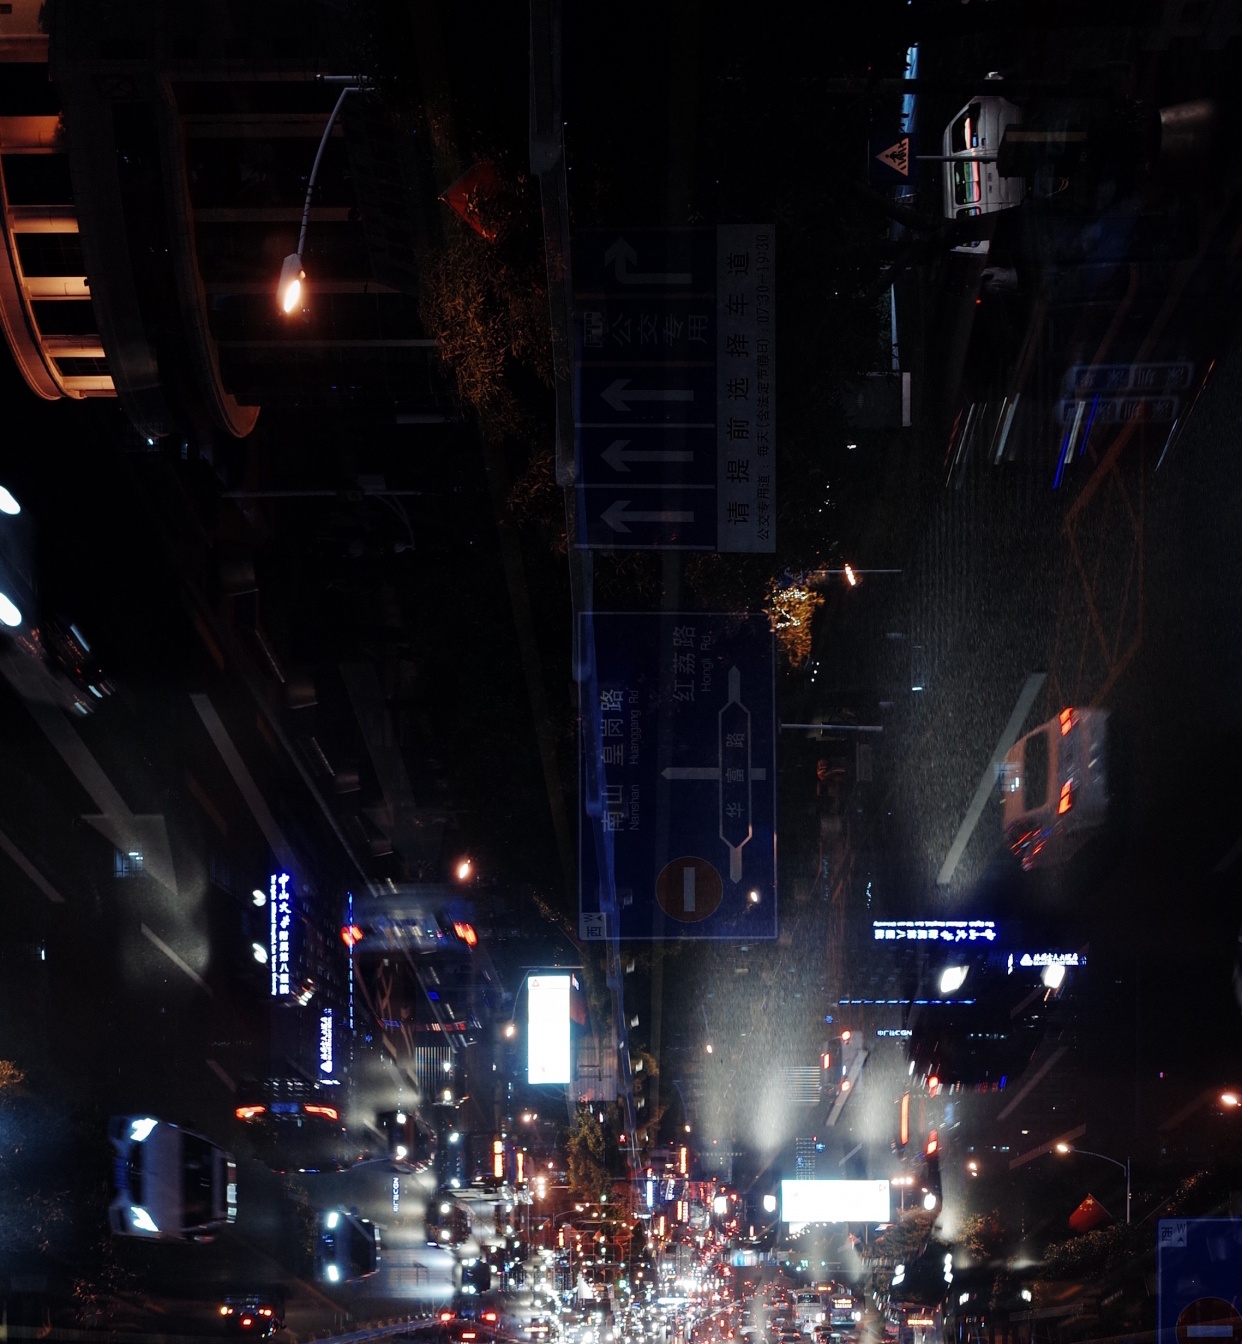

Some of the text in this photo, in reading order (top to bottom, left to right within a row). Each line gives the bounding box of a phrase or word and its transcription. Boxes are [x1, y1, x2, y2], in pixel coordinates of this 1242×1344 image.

[611, 313, 709, 346] 公交专用
[726, 252, 749, 524] 请提前选择车道
[672, 625, 696, 702] 红荔路
[701, 658, 713, 691] Hongli
[600, 689, 624, 831] 南山 皇岗路
[628, 690, 641, 830] Nanshan Huanggang Rd
[726, 732, 745, 818] 华富路
[584, 914, 602, 937] 西 W
